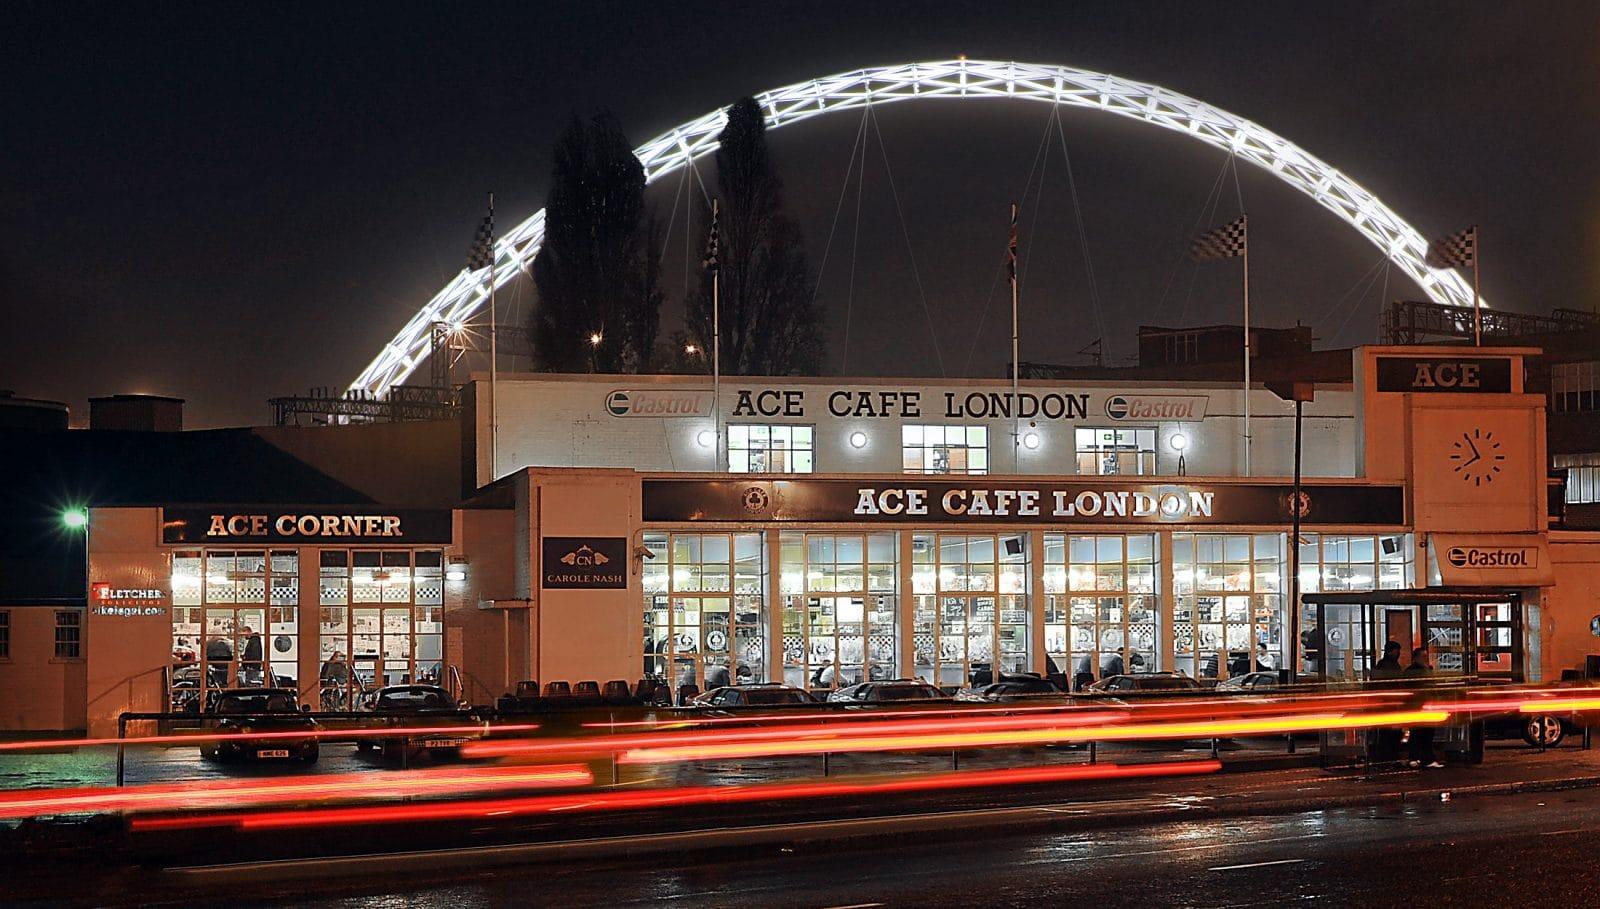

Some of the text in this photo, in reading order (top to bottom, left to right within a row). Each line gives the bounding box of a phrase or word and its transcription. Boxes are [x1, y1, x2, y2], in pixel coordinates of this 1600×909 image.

[1412, 363, 1480, 388] ACE
[631, 395, 701, 414] Castrol
[732, 390, 1090, 420] ACE CAFE LONDON
[1129, 399, 1193, 418] Castrol
[853, 488, 1215, 518] ACE CAFE LONDON
[206, 514, 404, 538] ACE CORNER
[576, 556, 592, 566] CN
[1467, 548, 1528, 566] Castrol
[547, 574, 622, 583] CAROLE NASH
[101, 587, 165, 600] FLETCHER
